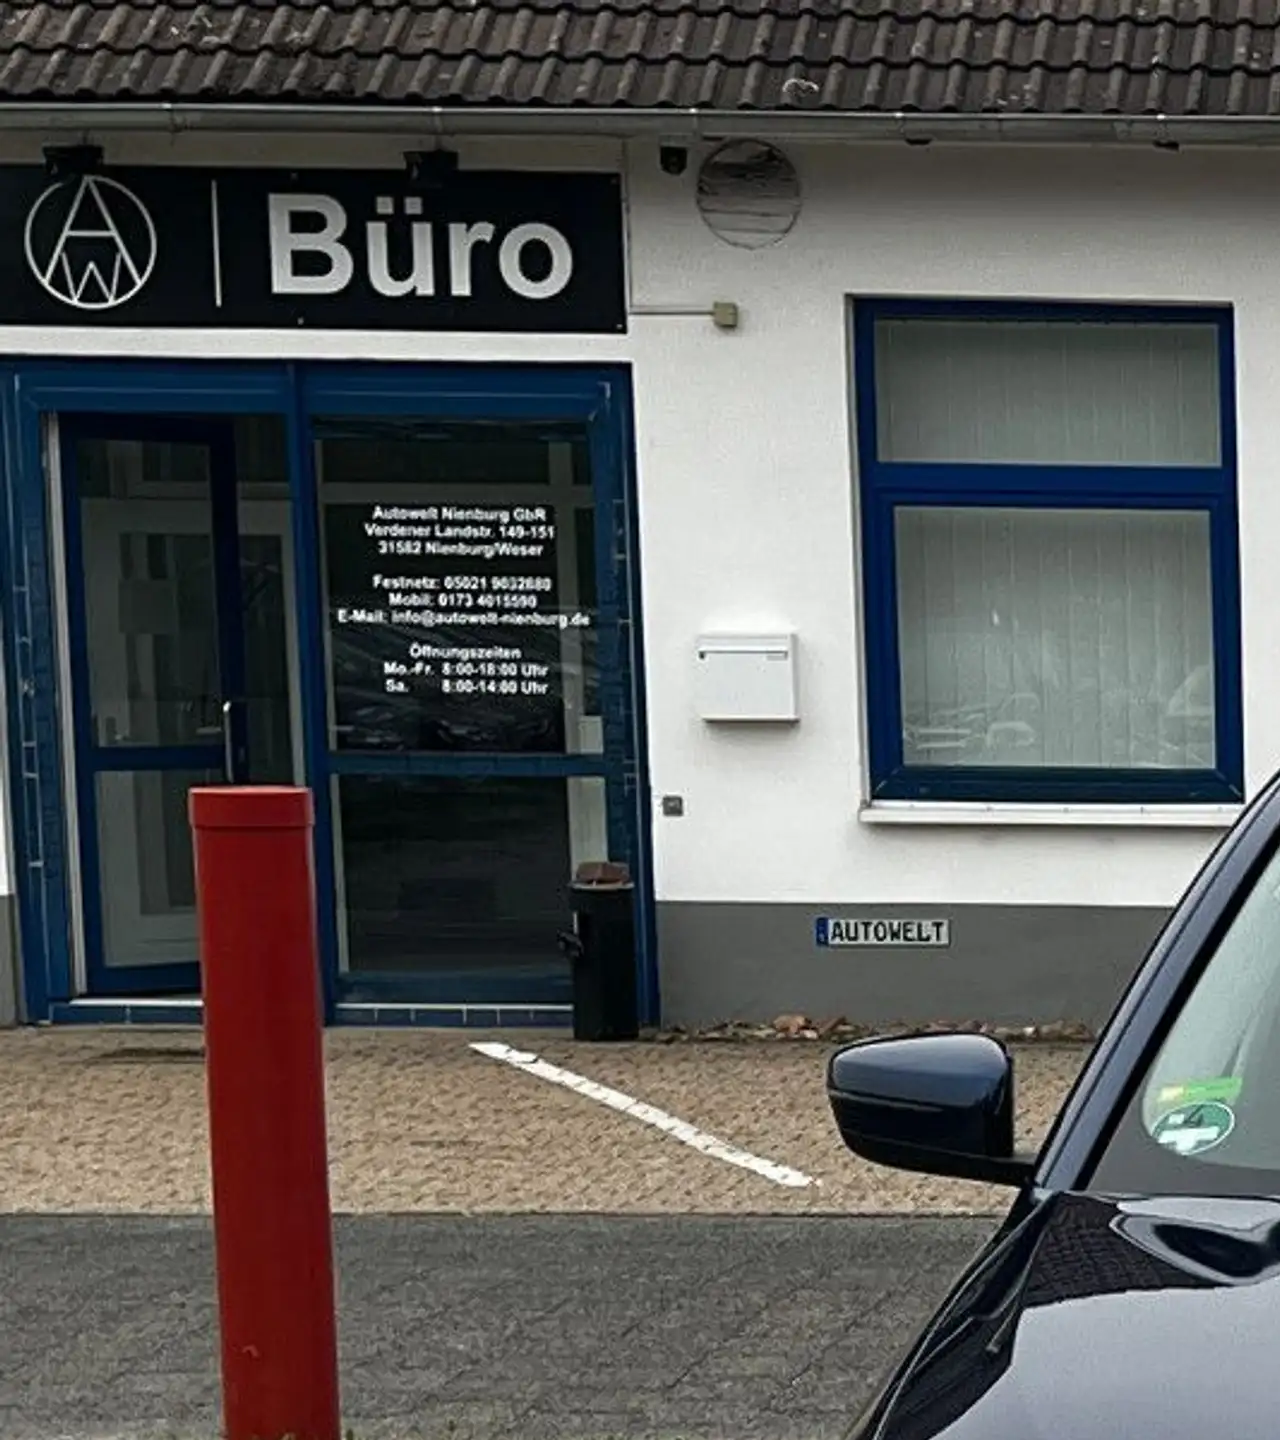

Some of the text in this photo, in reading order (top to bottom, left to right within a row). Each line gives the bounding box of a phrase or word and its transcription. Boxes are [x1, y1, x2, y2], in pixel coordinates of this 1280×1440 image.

[268, 192, 573, 299] Büro
[372, 506, 547, 523] Autowelt Nienburg GbR
[364, 523, 555, 540] Verdener Landstr. 149-151
[425, 542, 544, 559] Nienburg/Weser
[372, 574, 440, 589] Festnetz:
[444, 576, 487, 590] 05021
[388, 592, 435, 607] Mobil:
[438, 593, 473, 607] 0173
[337, 609, 590, 629] E-Mail: info@autowelt-nienburg.de
[409, 642, 522, 661] Öffnungszeiten
[521, 663, 549, 677] Uhr
[385, 680, 410, 693] Sa.
[521, 680, 549, 695] Uhr
[831, 921, 944, 942] AUTOWELT
